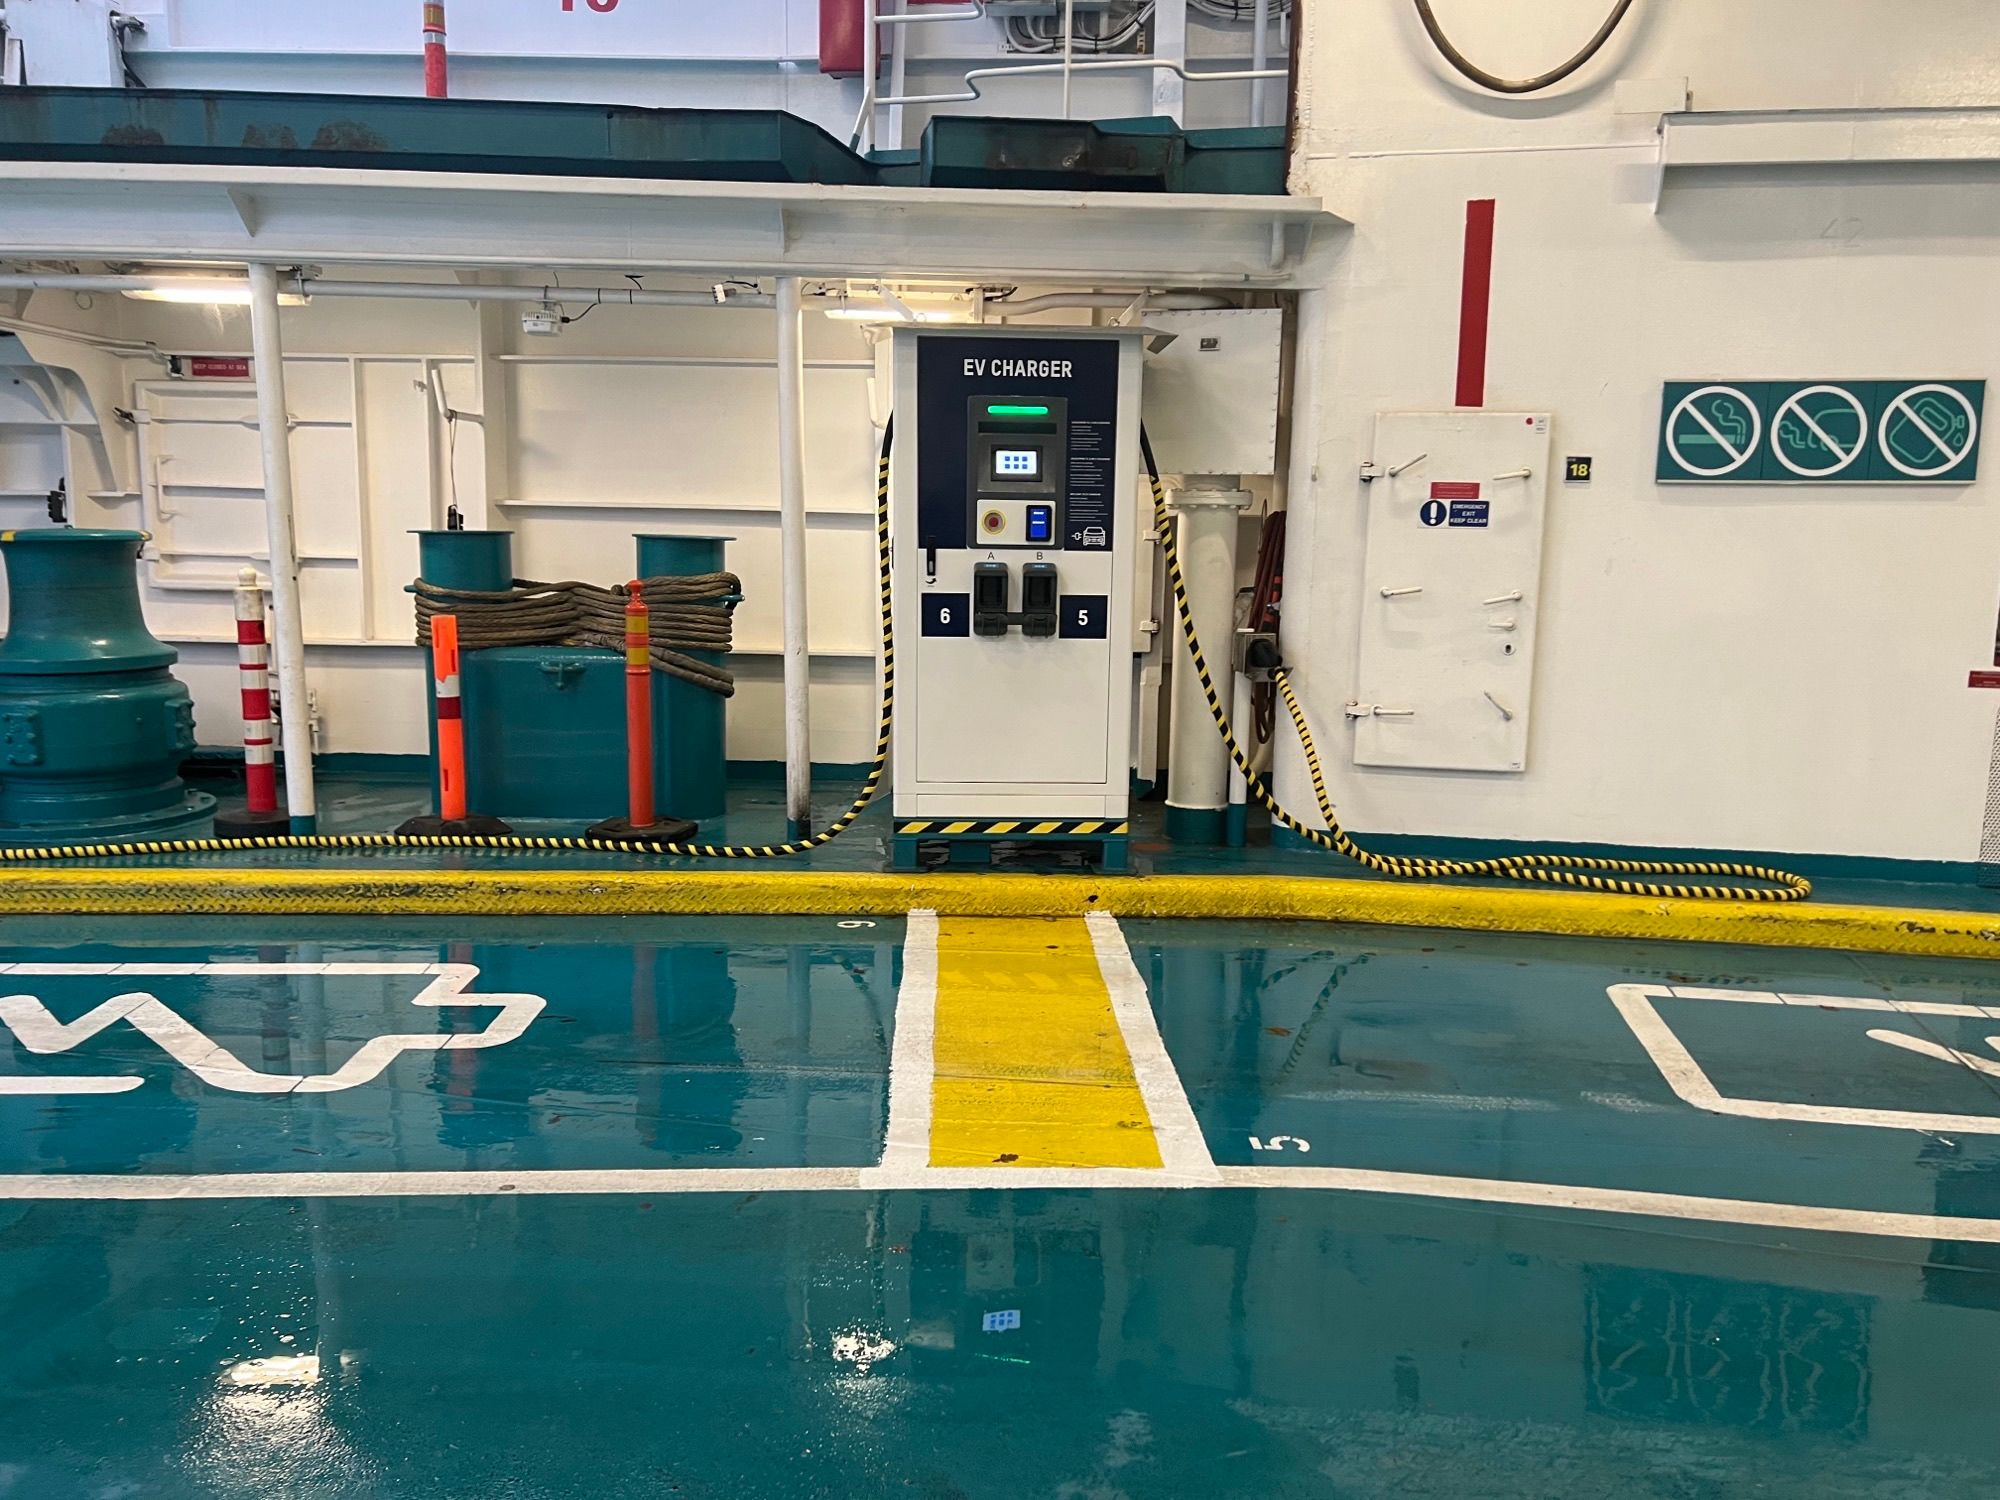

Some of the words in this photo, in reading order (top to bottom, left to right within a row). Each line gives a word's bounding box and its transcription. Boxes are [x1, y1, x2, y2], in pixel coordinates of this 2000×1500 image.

[963, 358, 987, 376] EV
[991, 359, 1073, 378] CHARGER
[1570, 463, 1588, 477] 18
[987, 551, 995, 560] A
[1036, 551, 1043, 560] B
[940, 607, 951, 624] 6
[1077, 609, 1089, 626] 5
[836, 920, 876, 928] 6
[1248, 1135, 1310, 1153] 5
